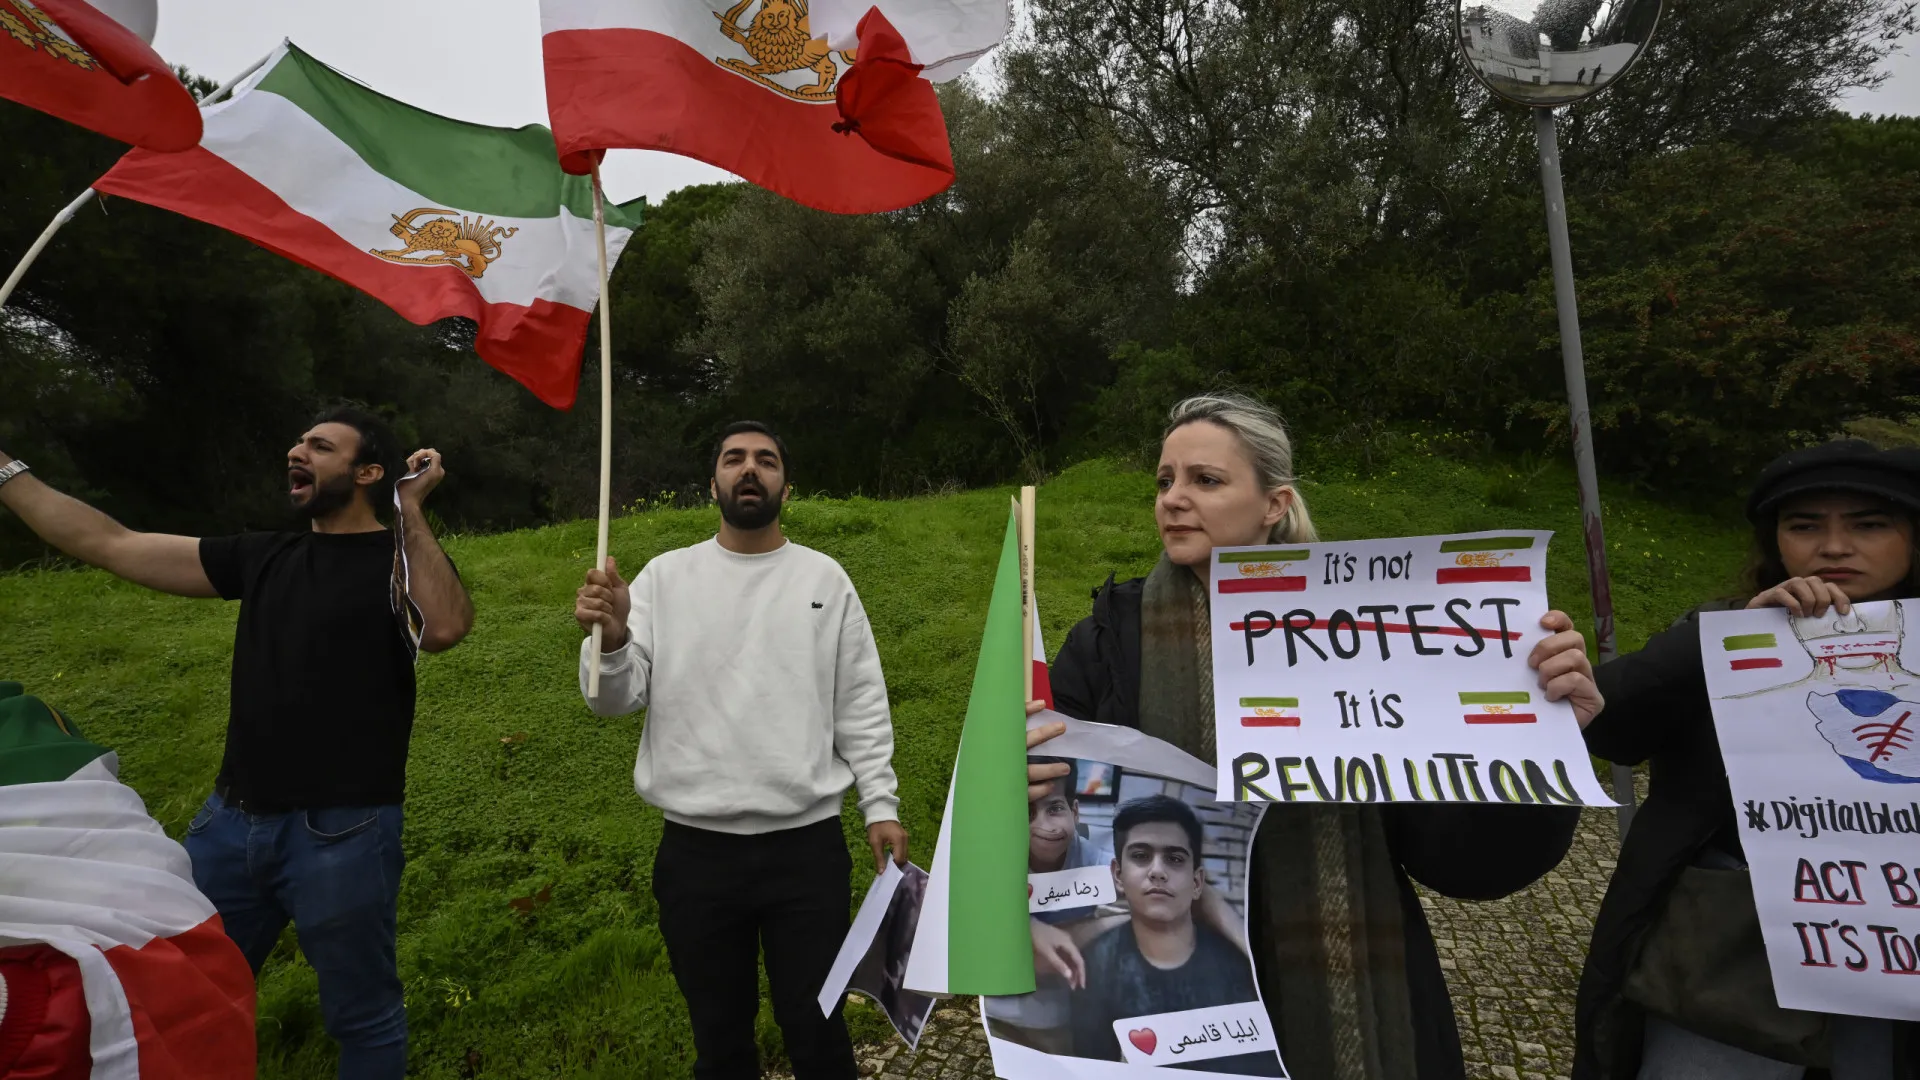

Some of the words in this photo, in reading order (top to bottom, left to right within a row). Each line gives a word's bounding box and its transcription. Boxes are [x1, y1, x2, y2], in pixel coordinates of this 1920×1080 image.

[1323, 552, 1357, 585] It's
[1369, 551, 1412, 580] not
[1243, 598, 1521, 668] PROTEST
[1333, 690, 1360, 729] It
[1369, 689, 1404, 729] is
[1074, 881, 1100, 898] رضا
[1794, 857, 1867, 903] ACT
[1792, 918, 1869, 972] IT'S
